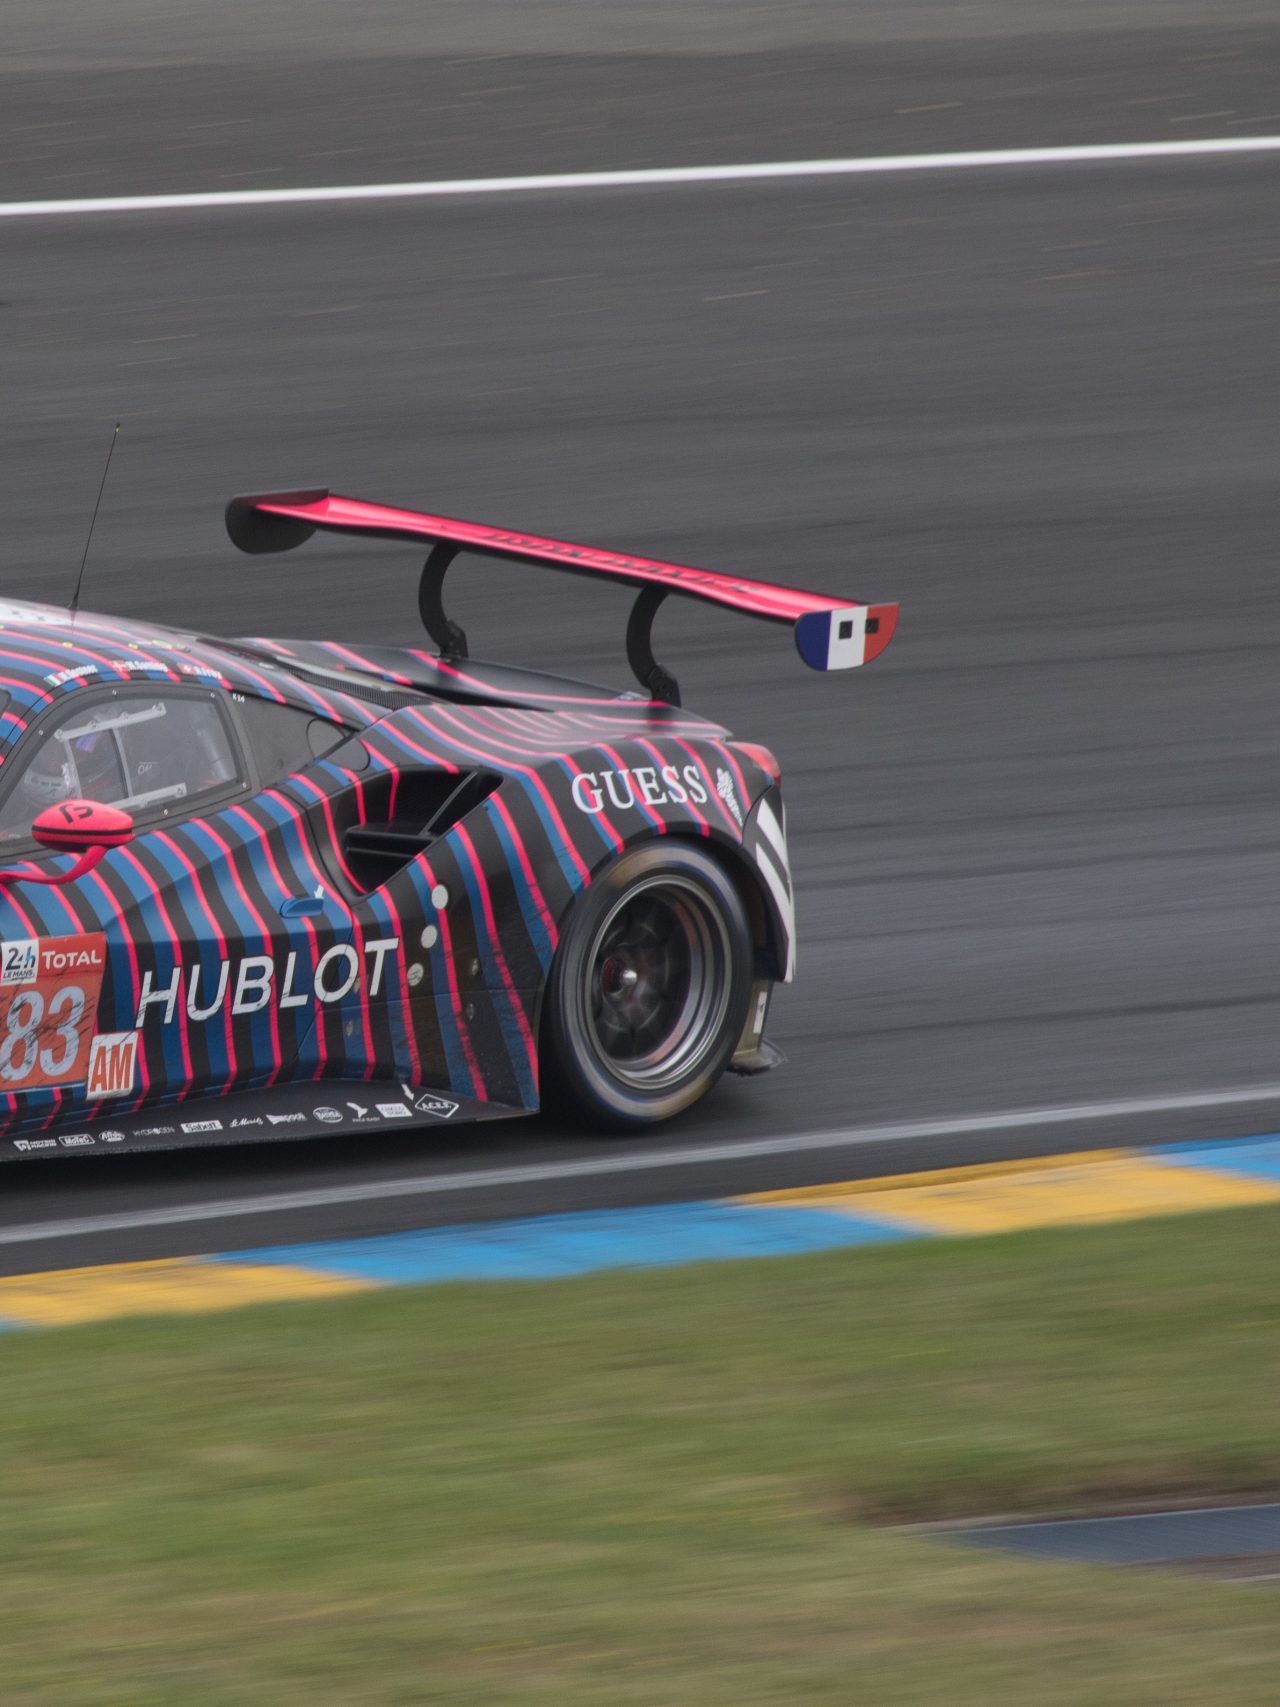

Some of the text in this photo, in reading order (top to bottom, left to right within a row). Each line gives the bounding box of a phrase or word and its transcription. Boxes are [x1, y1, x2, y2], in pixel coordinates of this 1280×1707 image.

[571, 765, 708, 814] GUESS
[42, 949, 102, 970] TOTAL
[135, 937, 399, 1028] HUBLOT
[89, 1042, 134, 1093] AM
